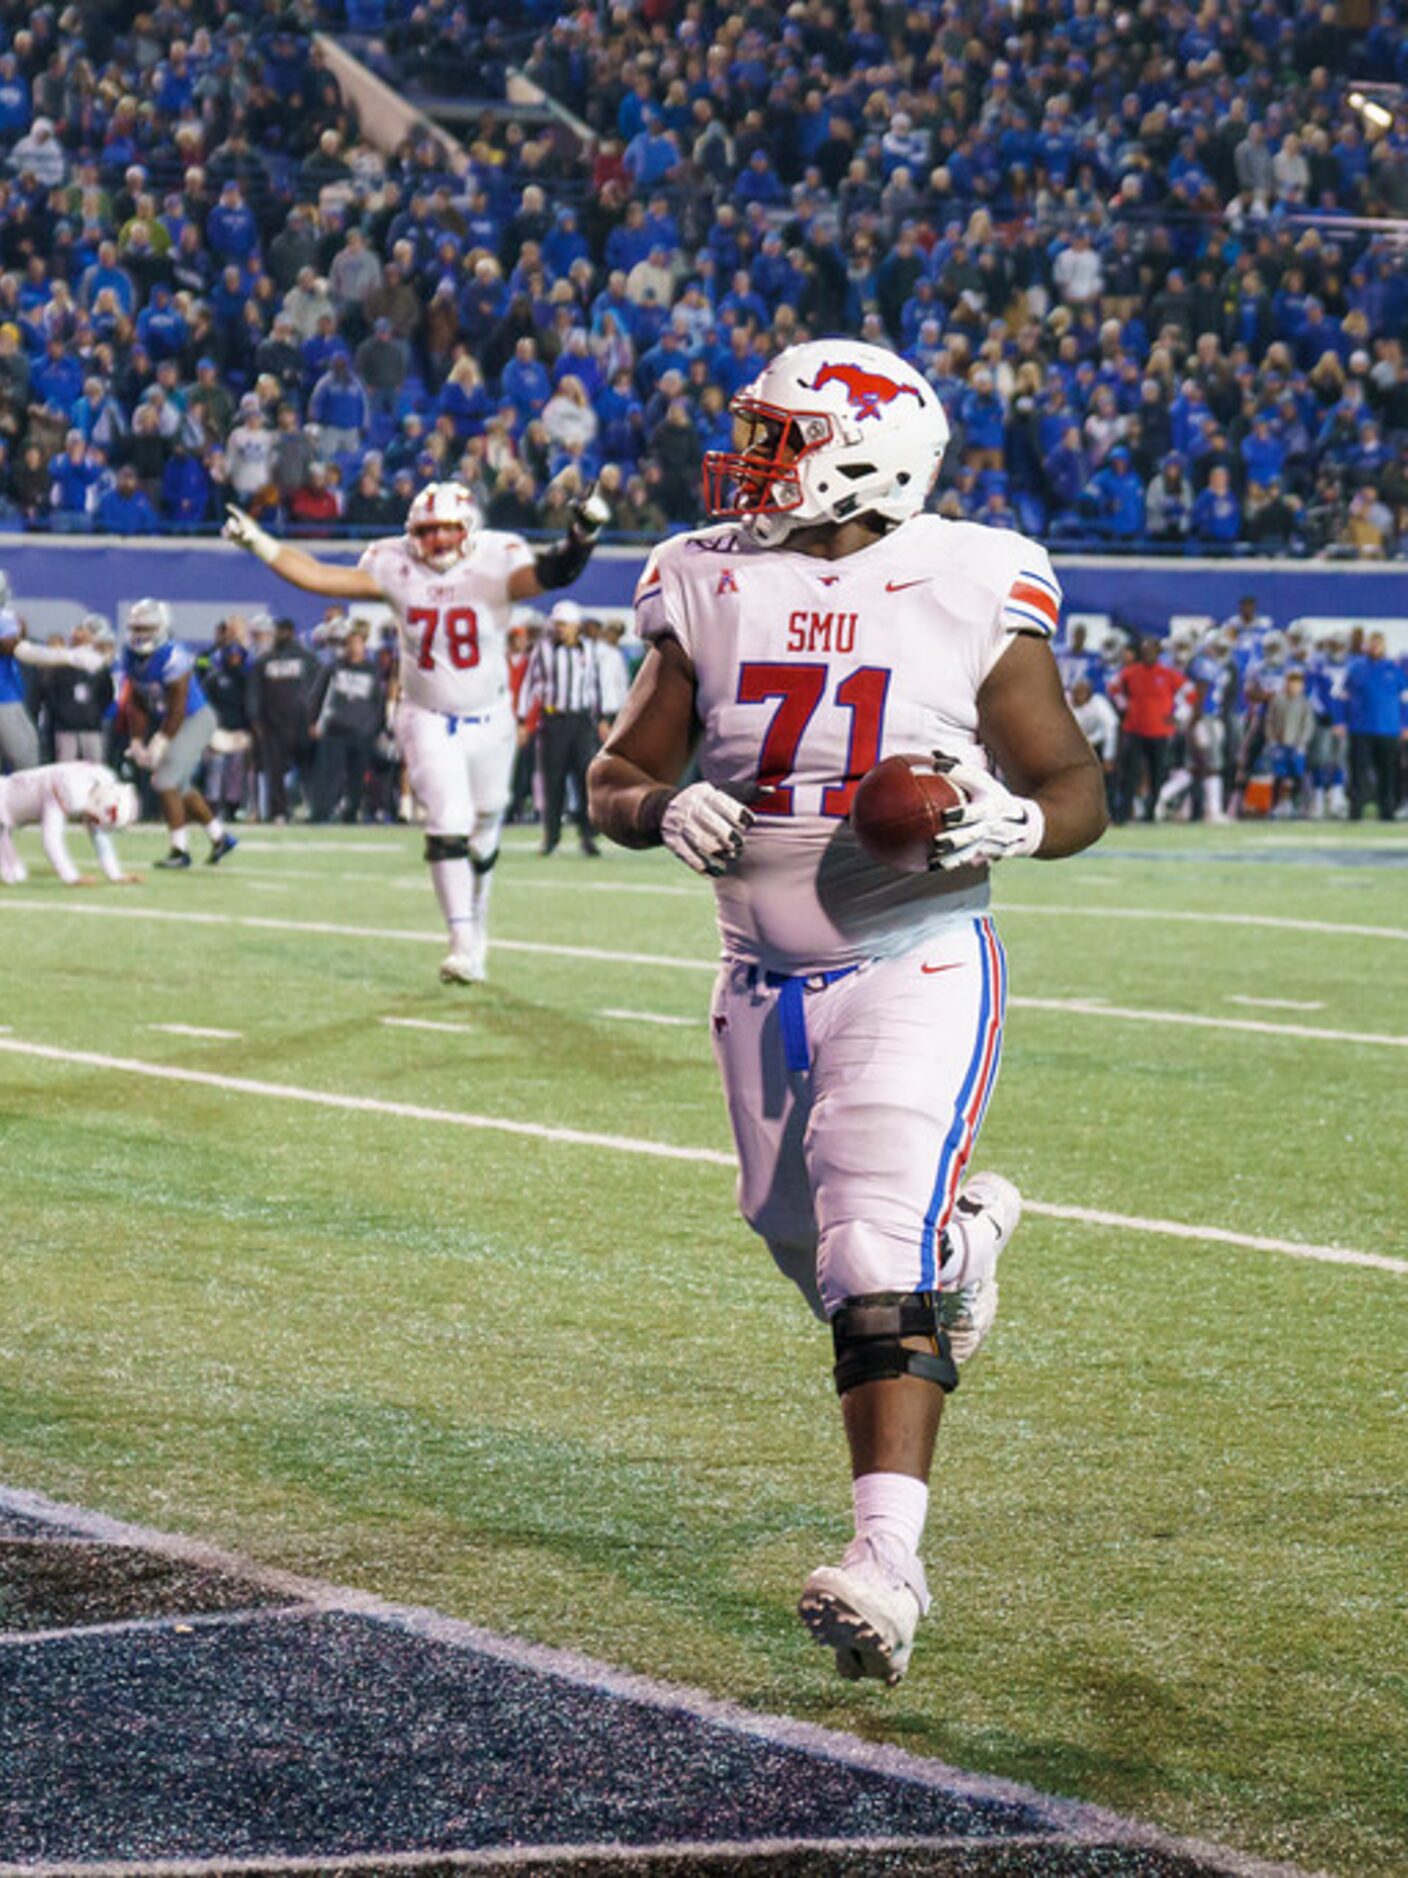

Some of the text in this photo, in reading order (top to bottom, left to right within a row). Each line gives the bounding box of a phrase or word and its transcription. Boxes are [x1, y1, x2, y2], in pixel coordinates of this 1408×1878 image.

[406, 605, 481, 671] 78
[786, 610, 858, 654] SMU
[735, 661, 892, 819] 71
